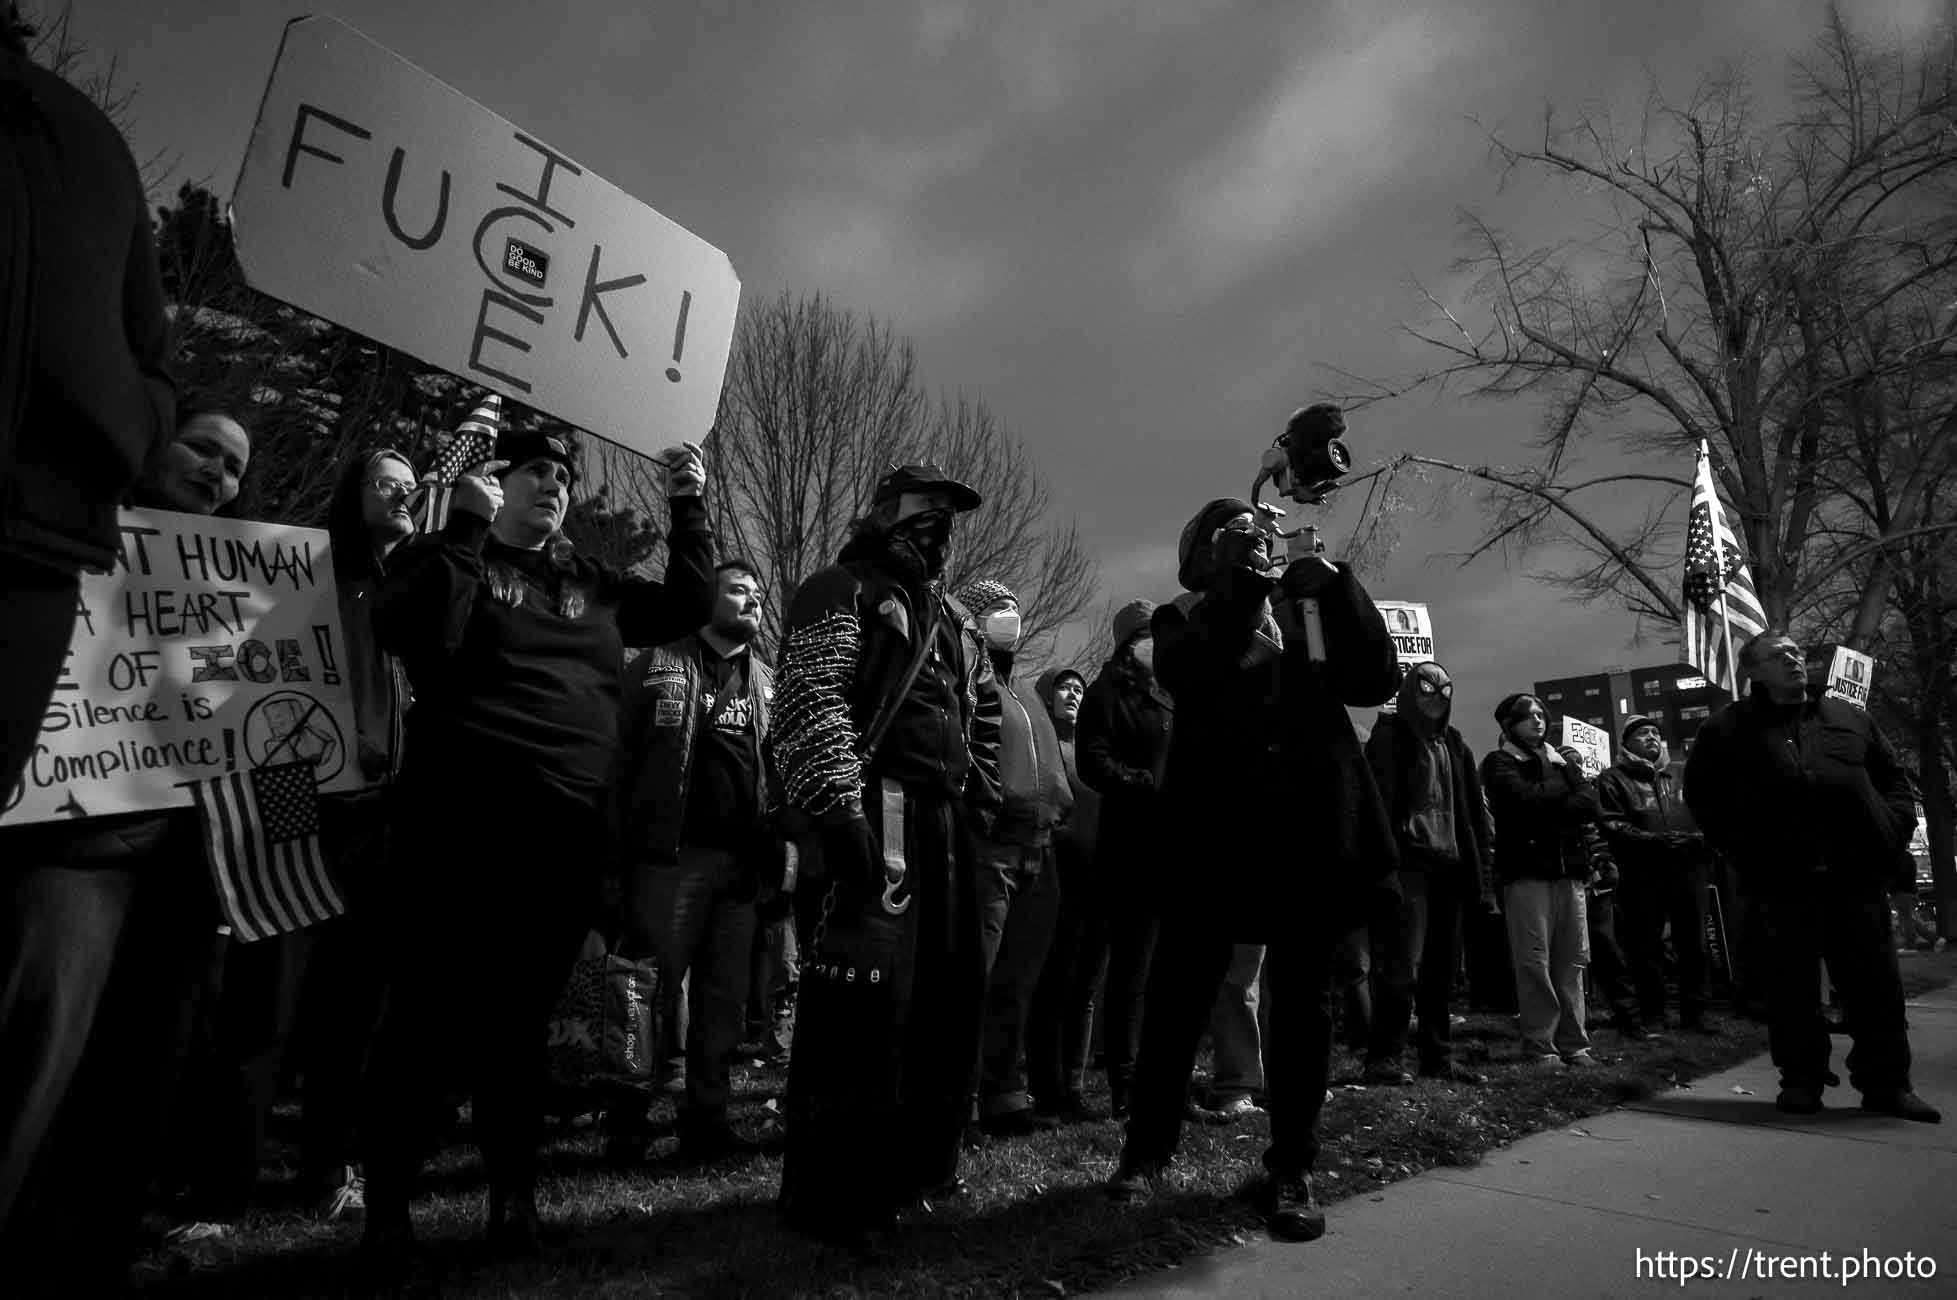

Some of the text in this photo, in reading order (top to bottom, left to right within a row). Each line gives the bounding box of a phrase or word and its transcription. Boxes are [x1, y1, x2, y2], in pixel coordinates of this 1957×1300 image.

[282, 104, 692, 383] FUCK!
[510, 244, 524, 256] DO
[508, 259, 544, 279] BE KIND
[176, 534, 314, 590] HUMAN
[126, 590, 251, 638] HEART
[1417, 637, 1433, 655] FOR
[108, 650, 161, 691] OF
[40, 693, 213, 732] Silence is
